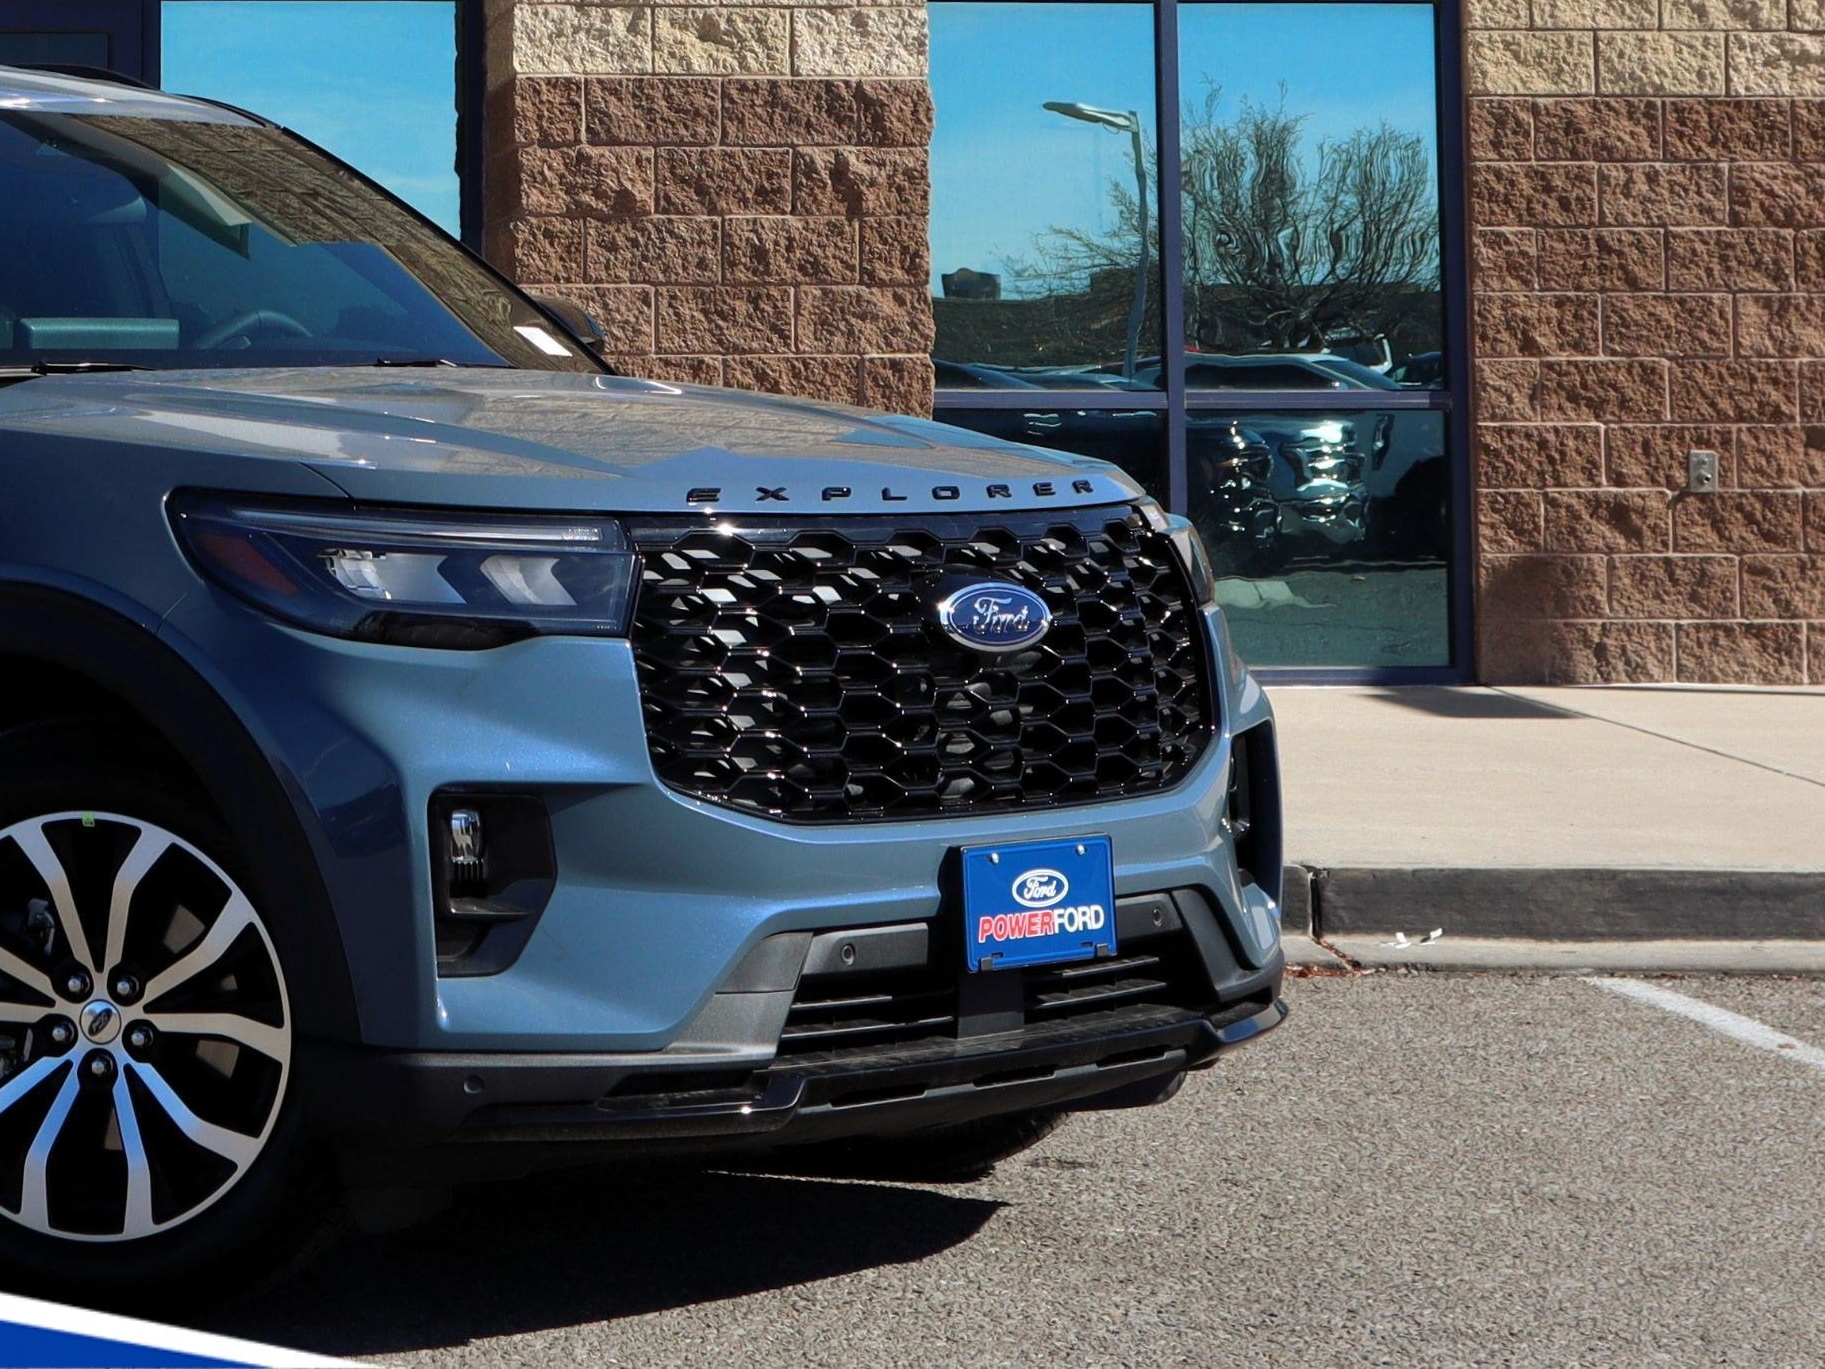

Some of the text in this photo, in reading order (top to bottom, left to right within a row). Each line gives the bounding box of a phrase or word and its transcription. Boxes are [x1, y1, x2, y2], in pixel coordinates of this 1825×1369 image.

[686, 479, 1094, 504] EXPLORER
[972, 596, 1030, 634] Ford
[1023, 875, 1057, 900] Ford
[978, 904, 1105, 944] POWERFORD
